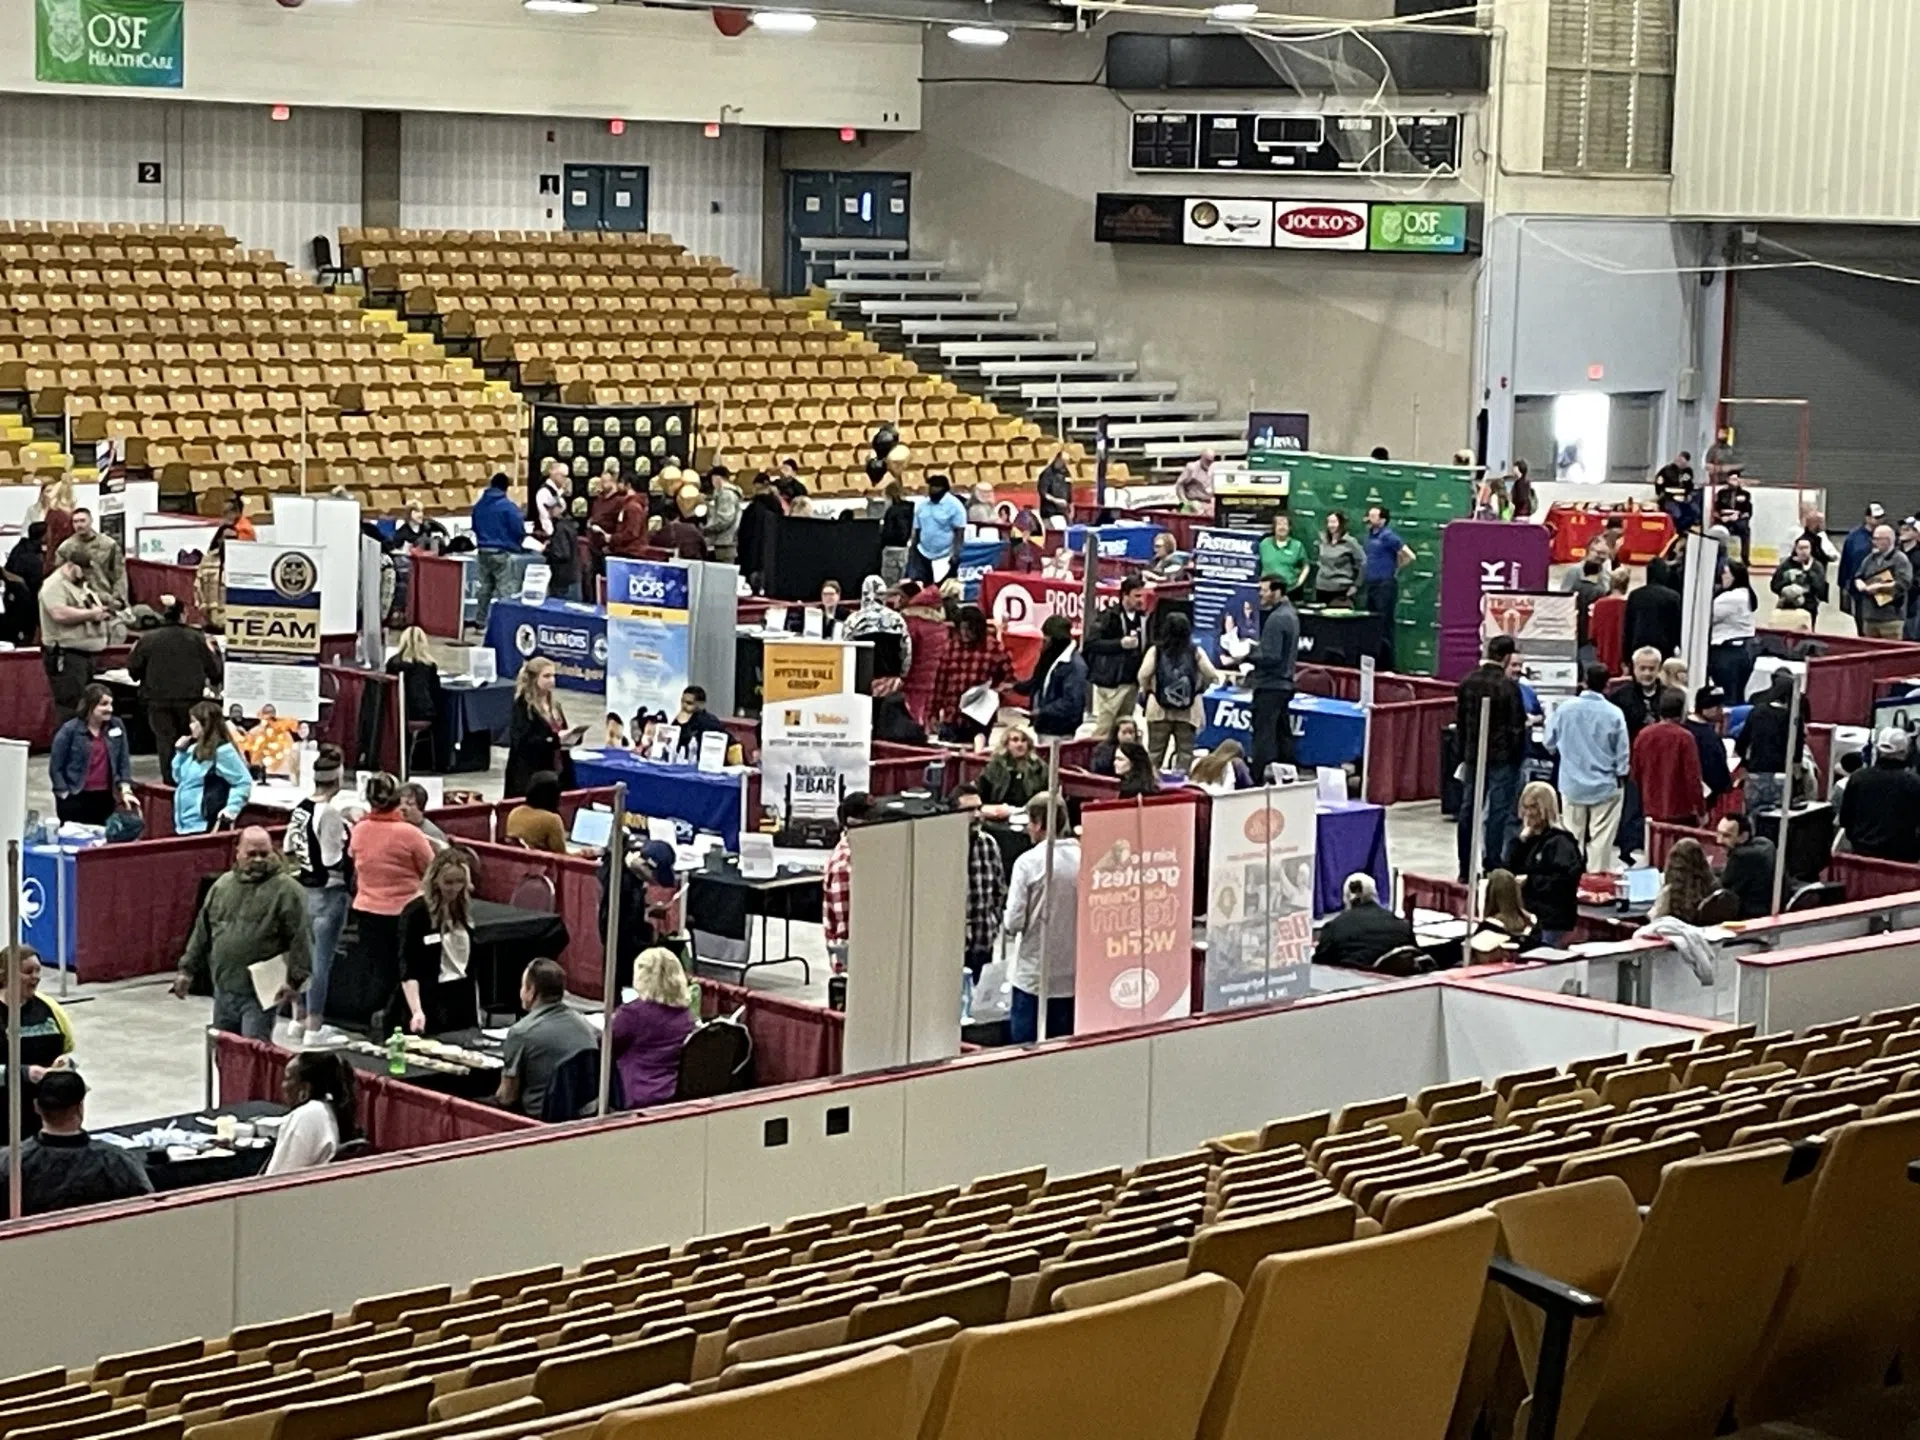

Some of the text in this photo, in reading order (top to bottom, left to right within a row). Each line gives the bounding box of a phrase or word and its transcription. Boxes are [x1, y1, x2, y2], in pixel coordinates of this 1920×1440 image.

[87, 13, 148, 49] OSF
[144, 164, 155, 180] 2
[1285, 213, 1358, 231] JOCKO'S
[1404, 211, 1441, 234] OSF
[227, 618, 316, 639] TEAM
[796, 765, 836, 777] RAISING
[806, 777, 835, 794] BAR
